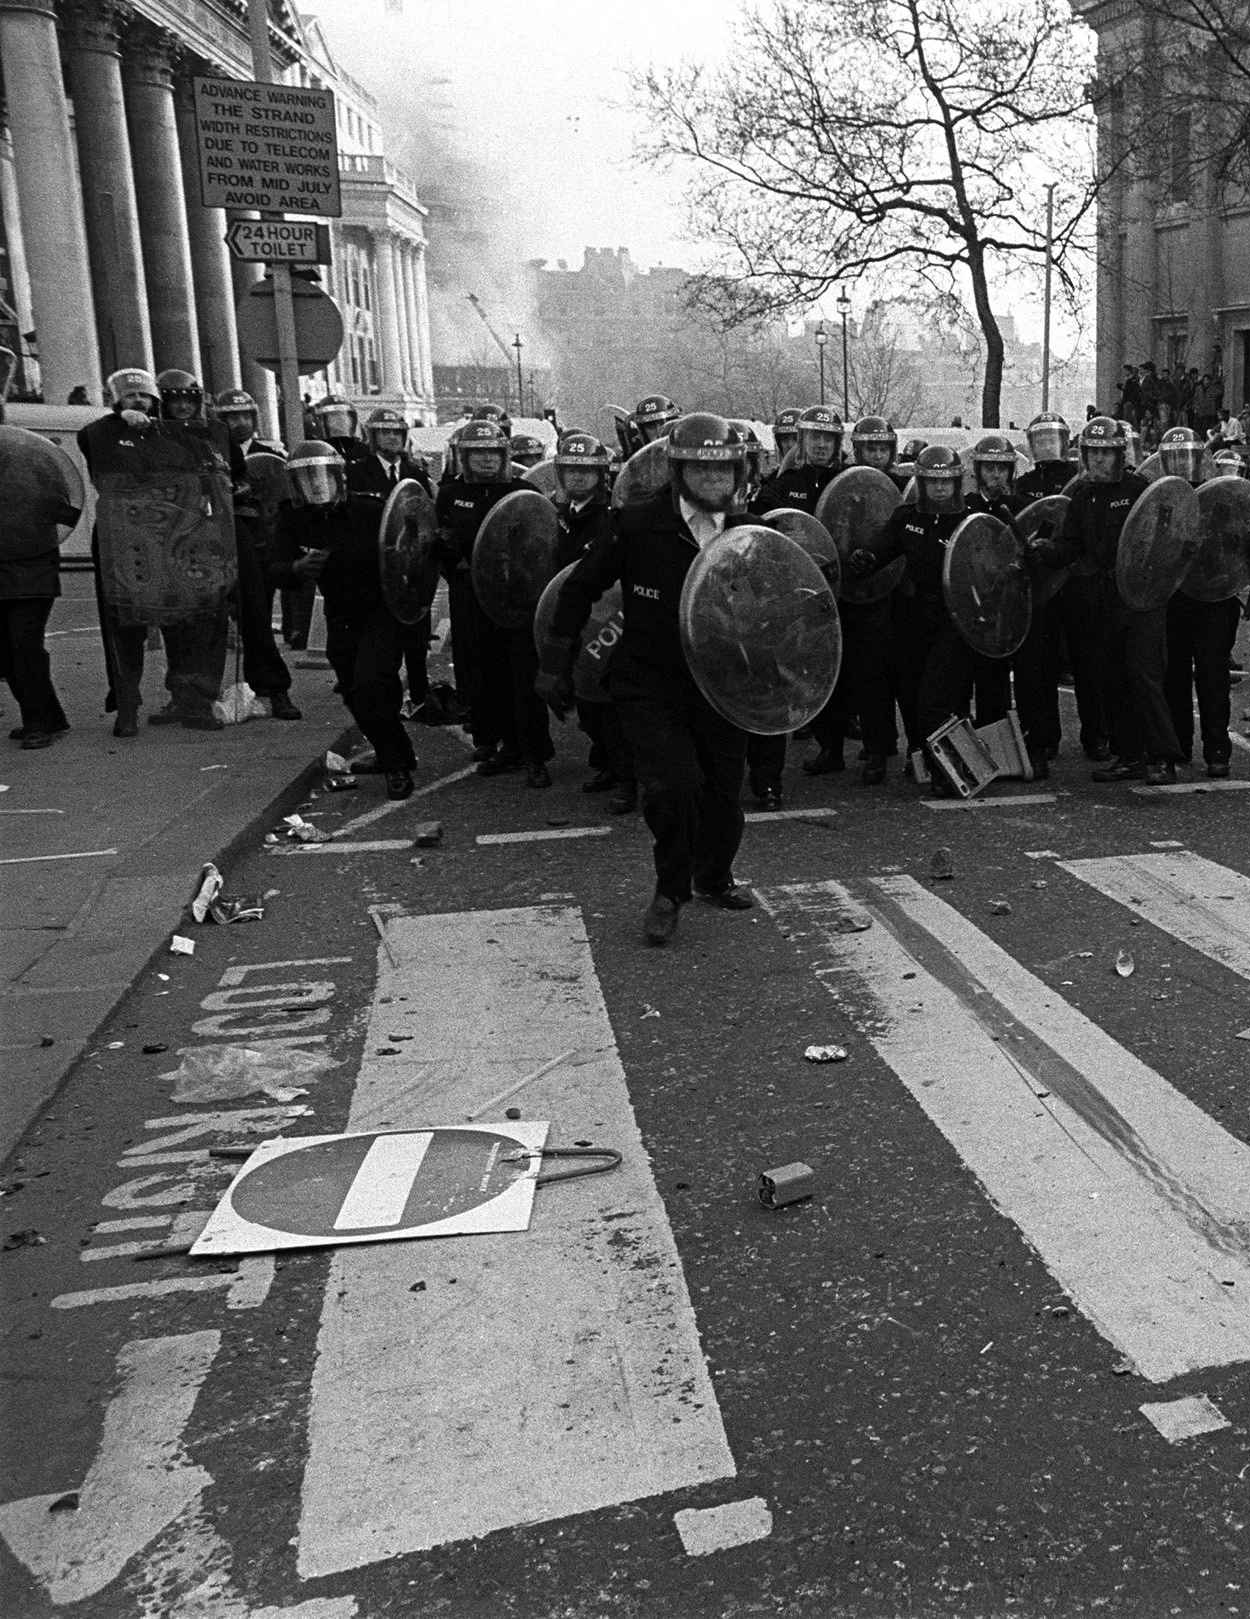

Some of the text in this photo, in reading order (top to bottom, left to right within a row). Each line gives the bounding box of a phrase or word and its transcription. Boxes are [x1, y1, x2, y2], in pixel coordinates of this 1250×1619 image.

[201, 83, 326, 109] ADVANCE WARNING
[213, 102, 316, 125] THE STRAND
[200, 120, 333, 144] WIDTH RESTRICTIONS
[205, 137, 330, 160] DUE TO TELECOM
[207, 155, 331, 177] AND WATER WORKS
[208, 172, 332, 195] FROM MID JULY
[226, 191, 320, 210] AVOID AREA
[242, 226, 314, 242] 24 HOUR
[250, 242, 307, 256] TOILET
[645, 402, 657, 412] 25
[782, 415, 794, 424] 25
[817, 412, 830, 422] 25
[476, 427, 491, 437] 25
[1091, 425, 1105, 435] 25
[1172, 433, 1185, 442] 25
[569, 442, 585, 453] 25
[454, 499, 475, 509] POLICE
[1110, 499, 1130, 508] POLICE
[905, 523, 925, 536] POLICE
[633, 584, 660, 600] POLICE
[585, 611, 625, 660] POL
